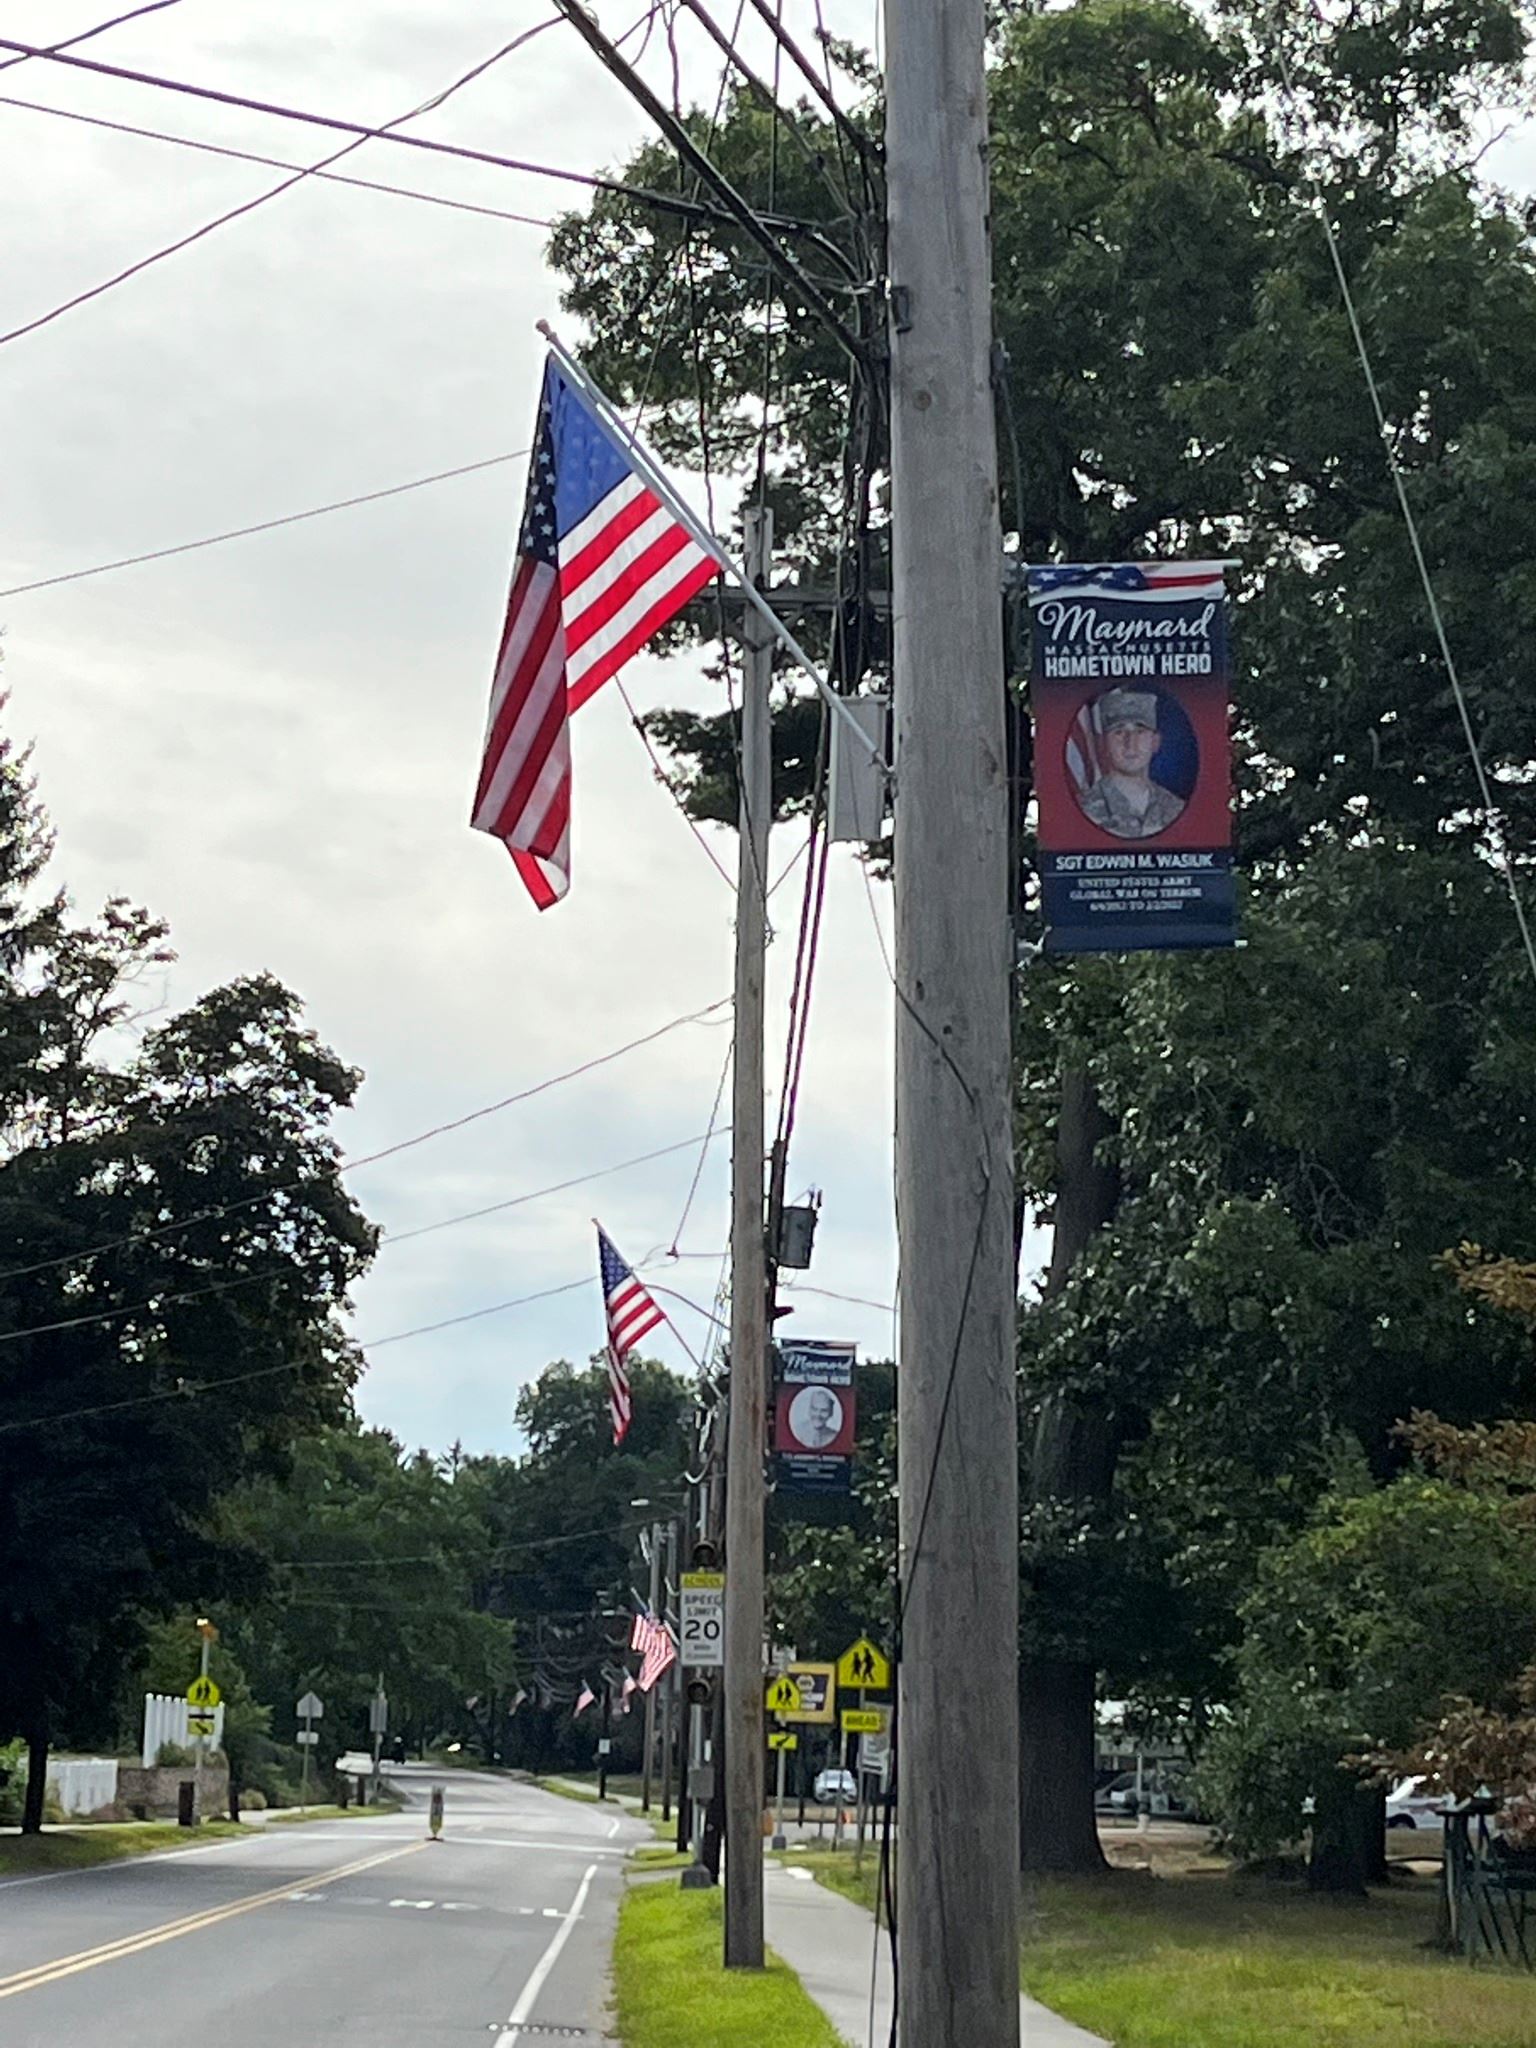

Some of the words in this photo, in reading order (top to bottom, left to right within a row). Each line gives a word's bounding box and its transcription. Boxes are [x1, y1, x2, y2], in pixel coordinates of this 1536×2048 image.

[1038, 602, 1215, 647] Maynard
[1044, 641, 1211, 656] MASSACHUSETTS
[1045, 654, 1155, 677] HOMETOWN
[1161, 653, 1212, 675] HERO
[1056, 855, 1083, 870] SGT
[1086, 854, 1135, 869] EDWIN
[1138, 854, 1155, 868] M.
[1078, 877, 1120, 888] UNITED
[1122, 876, 1160, 887] STATES
[1069, 889, 1114, 899] GLOBAL
[1141, 888, 1158, 898] ON
[687, 1606, 717, 1616] LIMIT
[685, 1619, 720, 1640] 20
